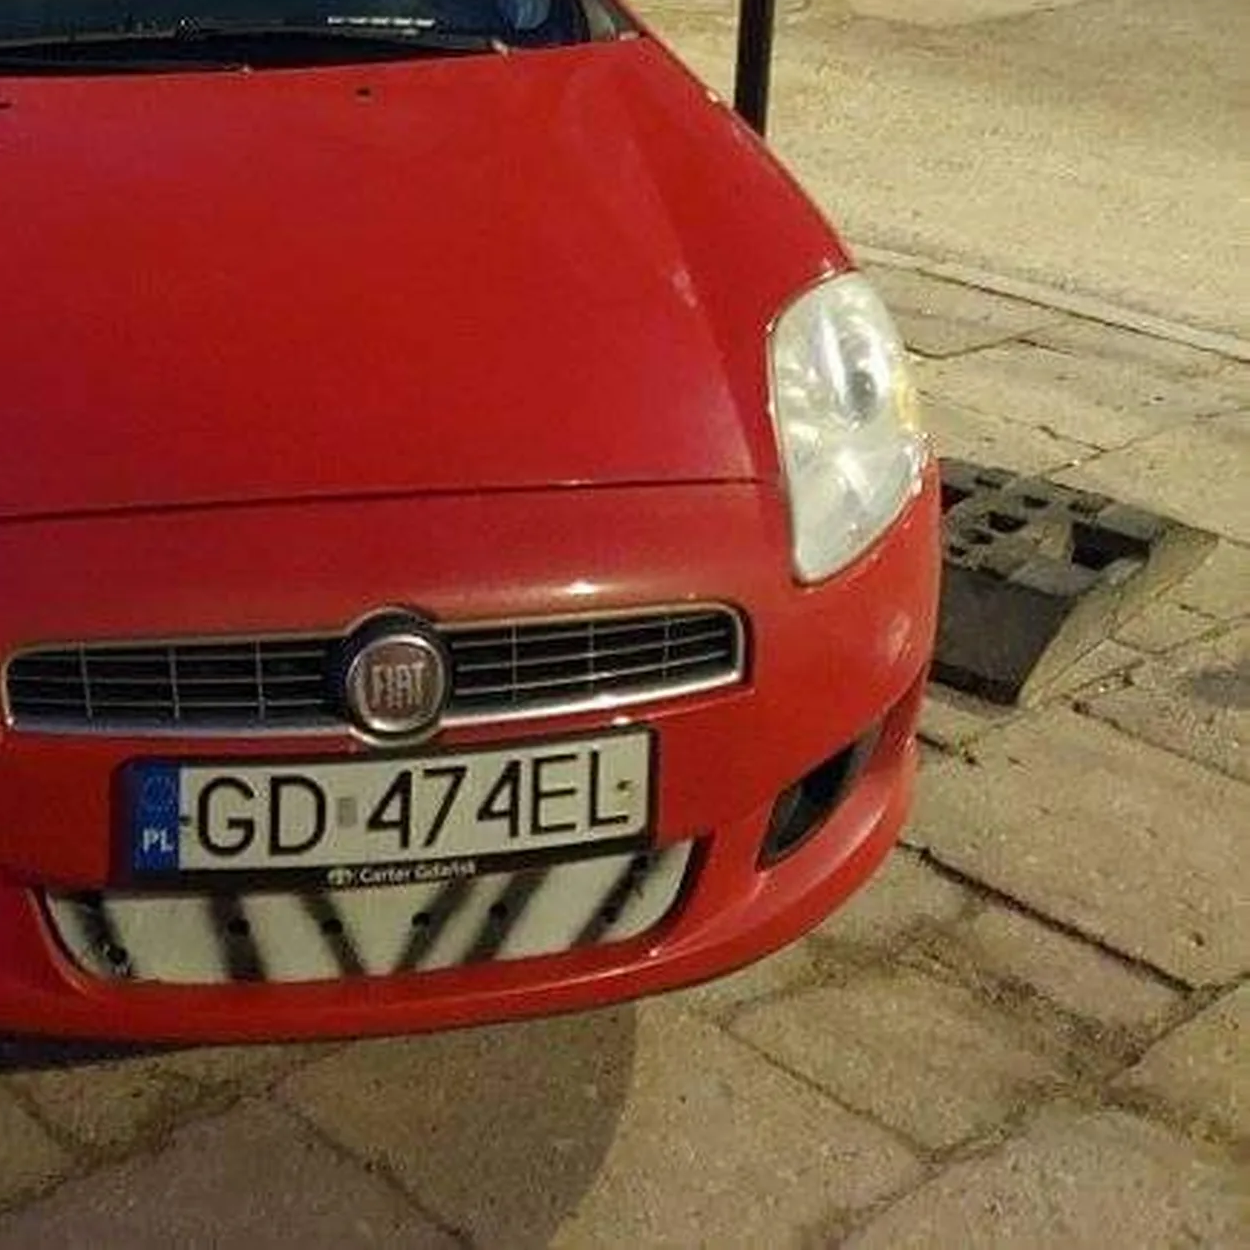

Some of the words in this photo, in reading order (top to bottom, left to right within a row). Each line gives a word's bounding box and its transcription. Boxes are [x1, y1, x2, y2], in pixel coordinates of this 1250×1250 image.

[371, 661, 427, 709] FIAT
[196, 774, 327, 857] GD
[366, 749, 630, 850] 474EL
[142, 827, 174, 853] PL
